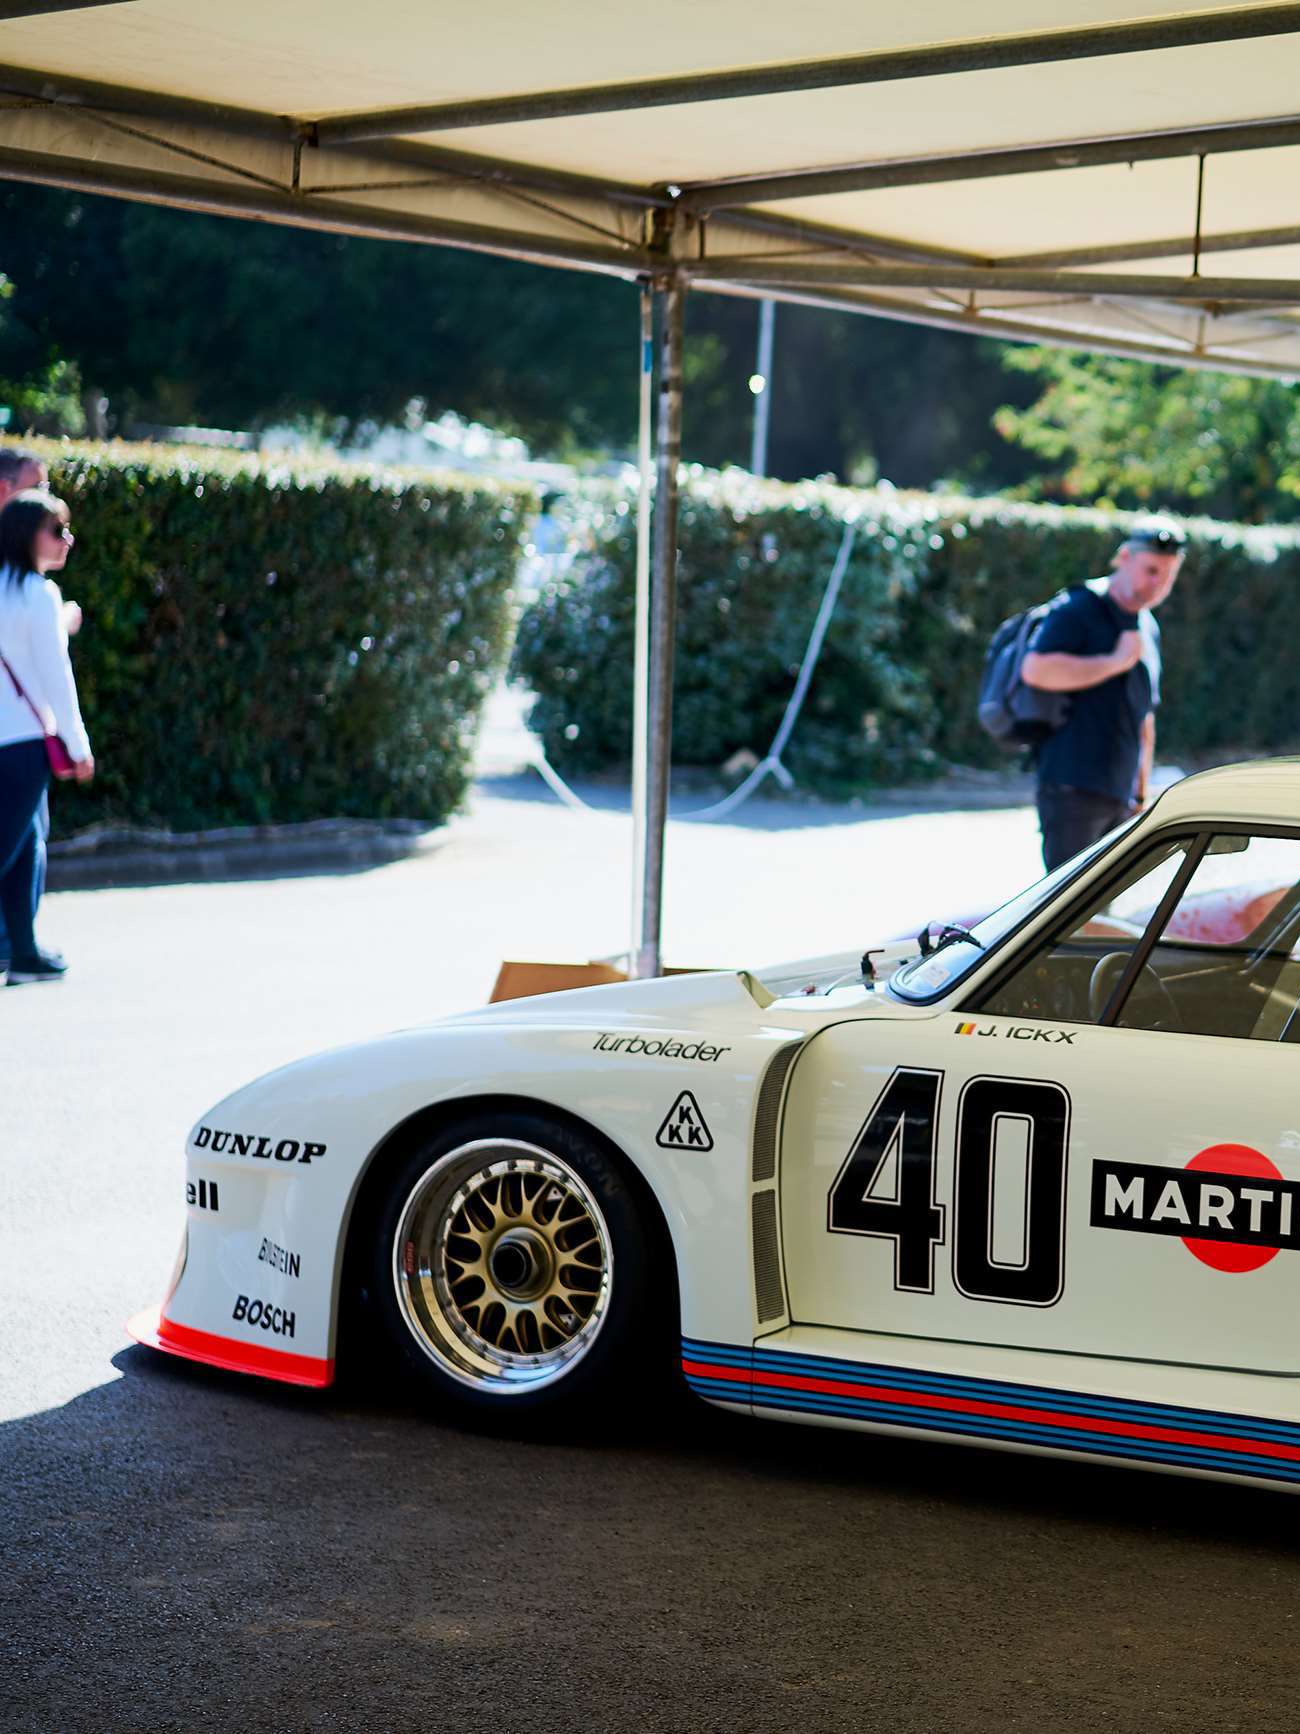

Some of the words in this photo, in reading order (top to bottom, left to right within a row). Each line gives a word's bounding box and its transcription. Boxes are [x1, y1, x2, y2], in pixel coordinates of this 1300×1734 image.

[593, 1031, 732, 1062] Turbolader
[977, 1025, 997, 1037] J.
[1006, 1026, 1078, 1045] ICKX
[194, 1126, 327, 1164] DUNLOP
[827, 1065, 1071, 1309] 40
[232, 1294, 296, 1338] BOSCH
